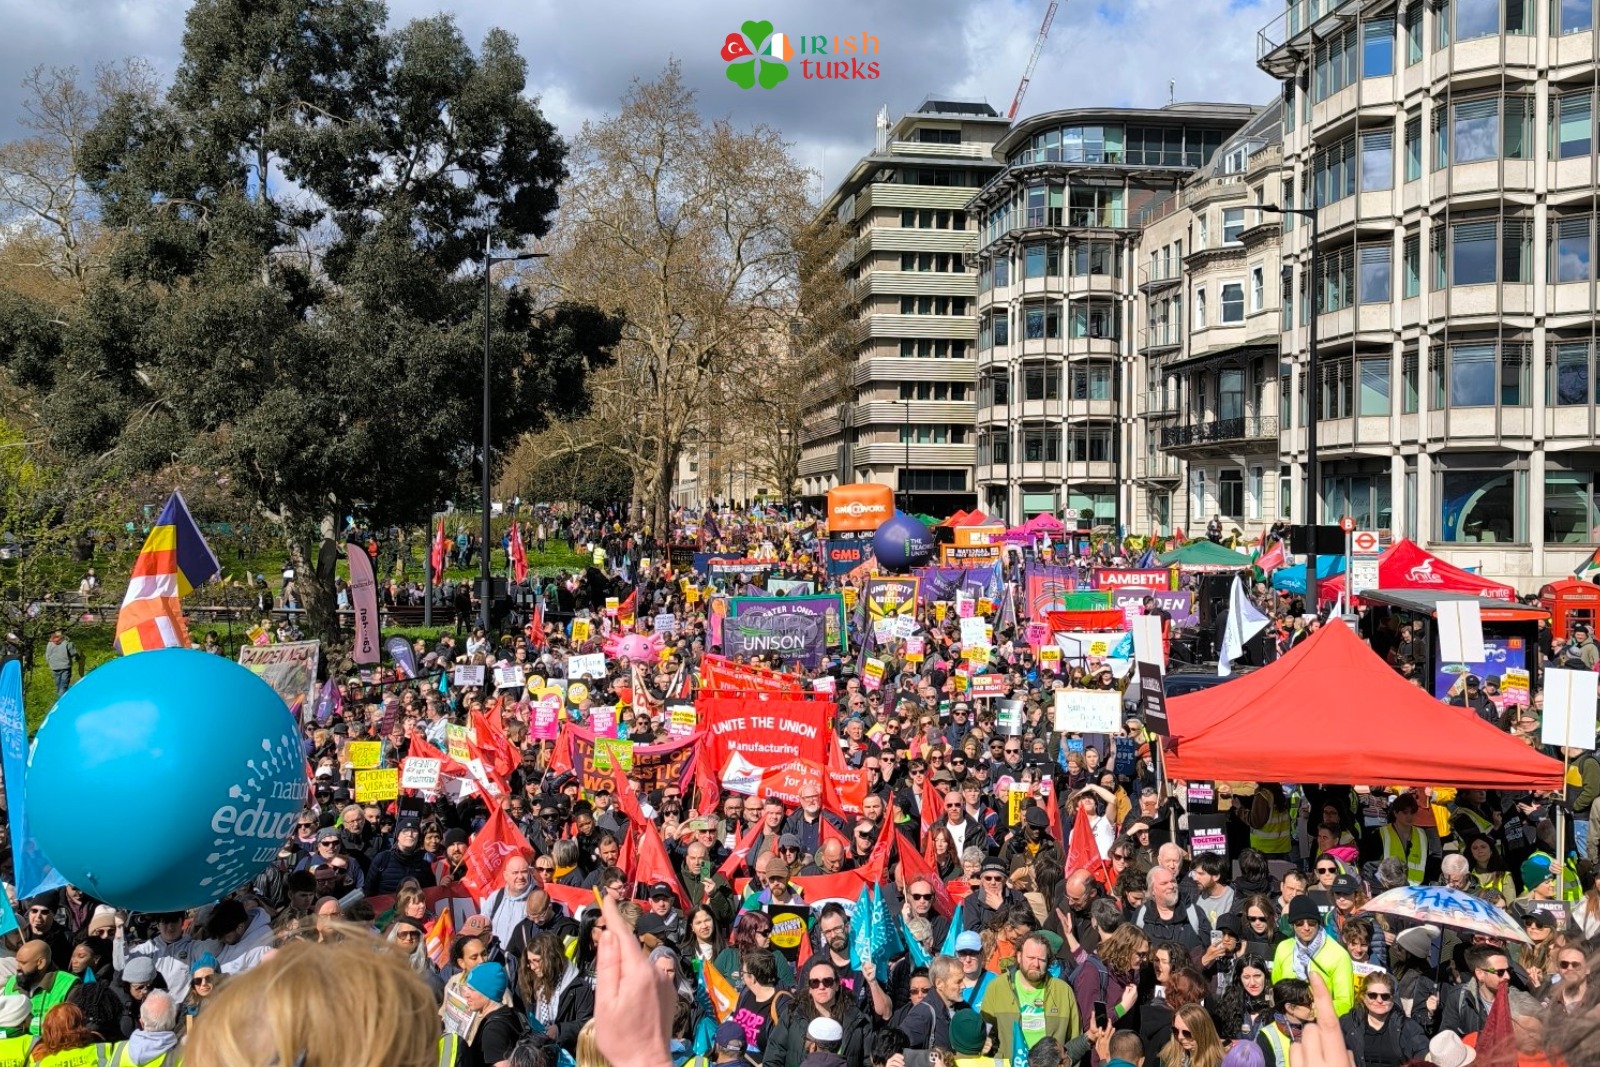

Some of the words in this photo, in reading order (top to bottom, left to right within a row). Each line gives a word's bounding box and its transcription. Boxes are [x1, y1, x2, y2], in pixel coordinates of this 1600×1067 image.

[1345, 519, 1352, 528] B
[831, 549, 860, 561] GMB
[1100, 573, 1166, 585] LAMBETH
[870, 584, 913, 594] UNIVERSITY
[743, 635, 805, 650] UNISON
[712, 718, 747, 734] UNITE
[751, 717, 775, 728] THE
[779, 718, 817, 739] UNION
[728, 740, 799, 756] Manufacturing
[364, 782, 384, 791] VISA
[784, 775, 800, 787] for
[765, 787, 800, 802] Domes
[1537, 902, 1563, 911] MARCH
[735, 1008, 764, 1028] STOP
